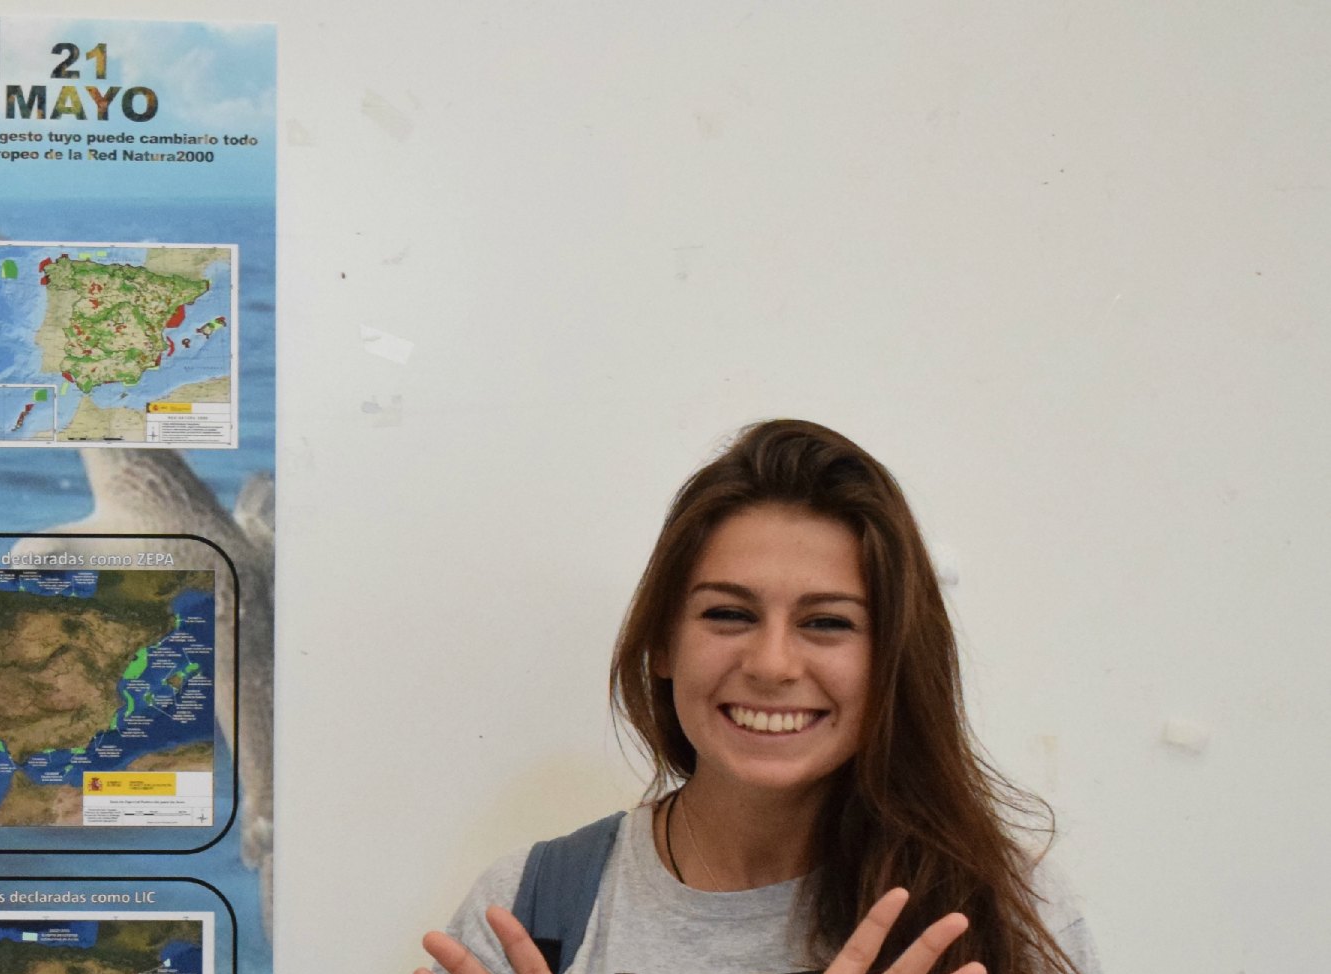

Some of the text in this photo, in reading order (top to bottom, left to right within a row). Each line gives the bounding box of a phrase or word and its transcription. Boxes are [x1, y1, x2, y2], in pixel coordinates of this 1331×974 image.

[51, 43, 107, 80] 21
[6, 85, 159, 122] MAYO
[1, 552, 84, 566] declaradas
[90, 556, 131, 566] como
[137, 554, 175, 566] ZEPA
[10, 891, 86, 903] declaradas
[91, 895, 130, 903] como
[136, 892, 155, 903] LIC
